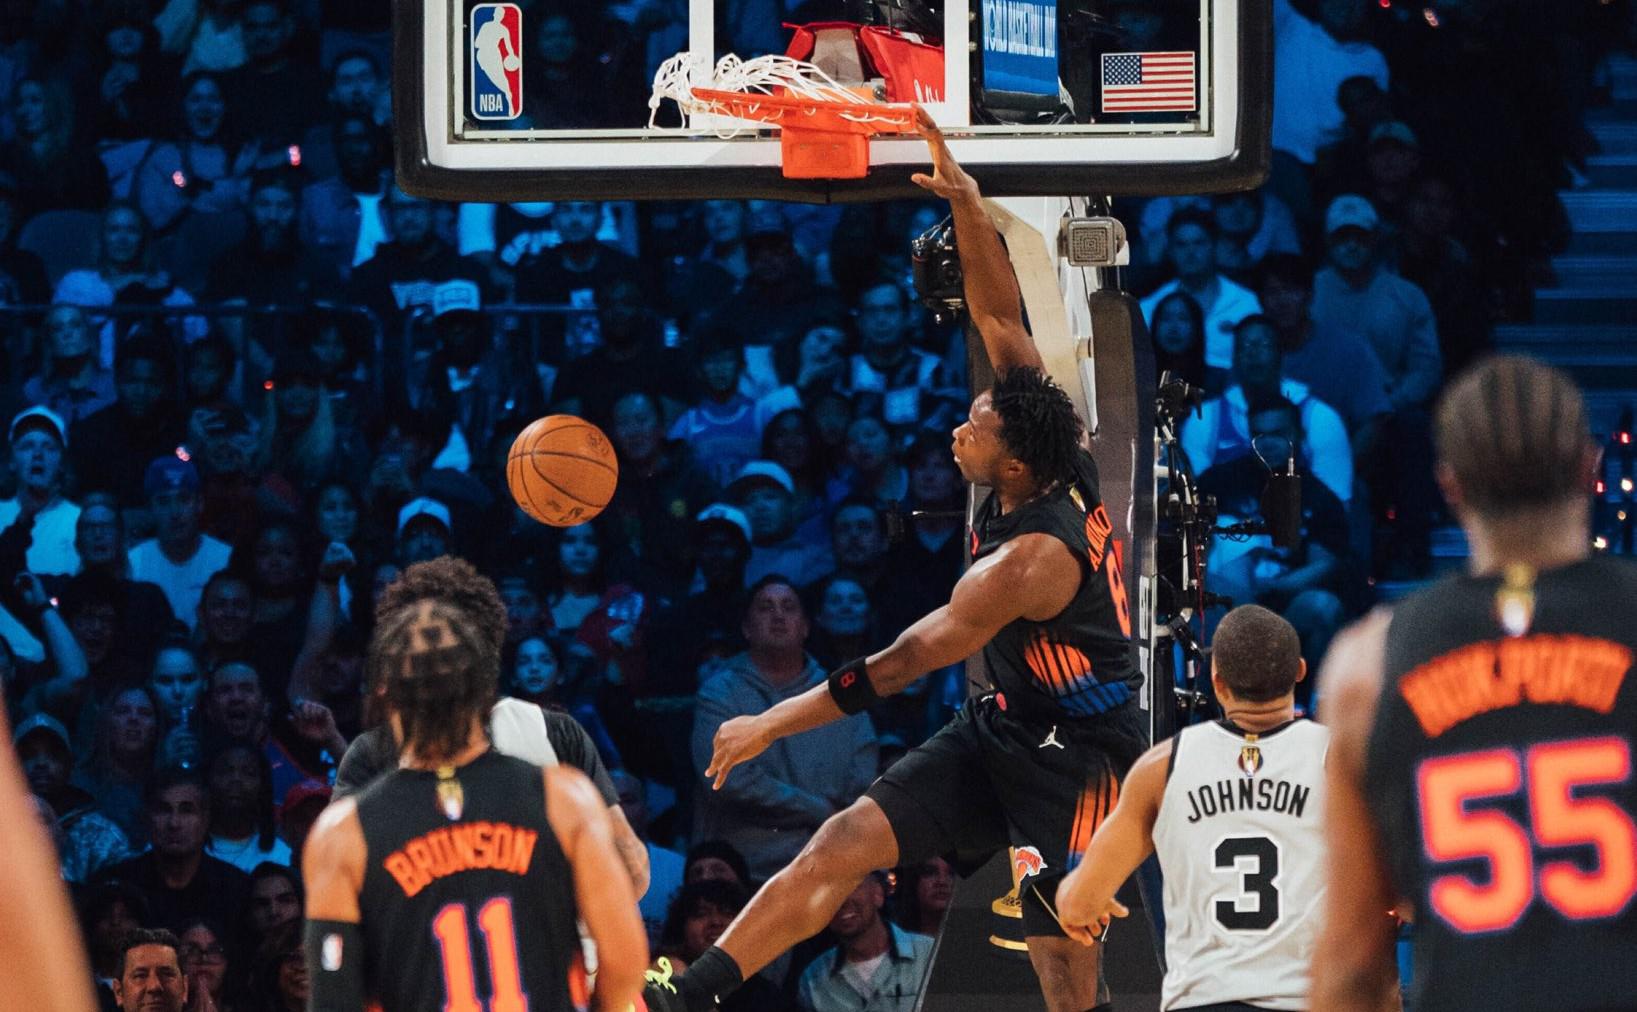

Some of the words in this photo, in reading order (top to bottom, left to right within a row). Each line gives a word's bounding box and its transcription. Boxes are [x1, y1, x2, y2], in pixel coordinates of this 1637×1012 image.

[480, 94, 503, 112] NBA
[1106, 551, 1131, 639] 8
[841, 671, 855, 688] 8
[1187, 778, 1310, 823] JOHNSON
[1417, 736, 1637, 933] 55
[384, 821, 539, 897] BRUNSON
[1213, 835, 1281, 932] 3
[433, 897, 528, 1012] 11
